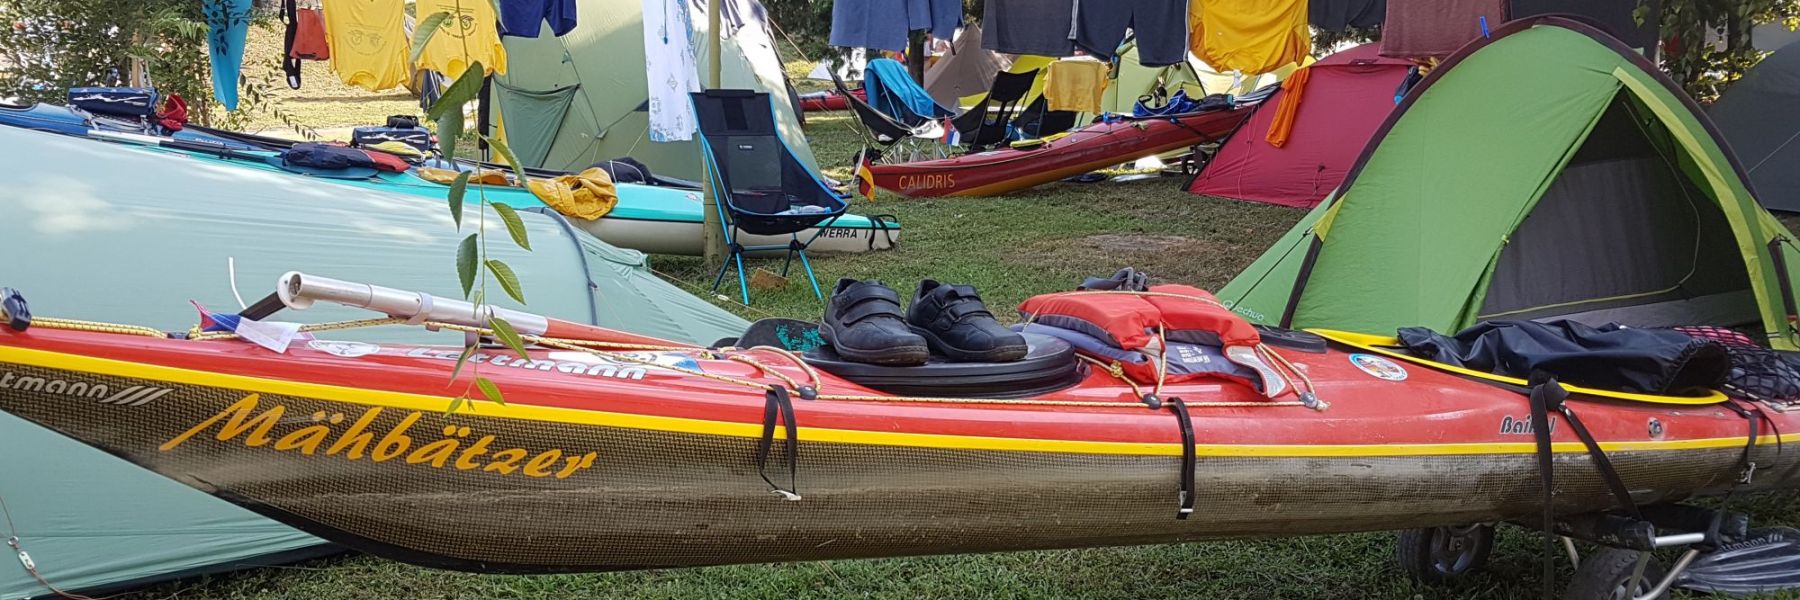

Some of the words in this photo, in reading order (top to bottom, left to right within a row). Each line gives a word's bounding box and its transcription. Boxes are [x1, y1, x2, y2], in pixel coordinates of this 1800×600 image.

[898, 173, 956, 190] CALIDRIS
[819, 228, 857, 239] WERRA
[1222, 299, 1264, 321] Qechua
[0, 371, 109, 398] tmann
[1500, 414, 1557, 435] Bail
[159, 393, 597, 479] Mähbätzer
